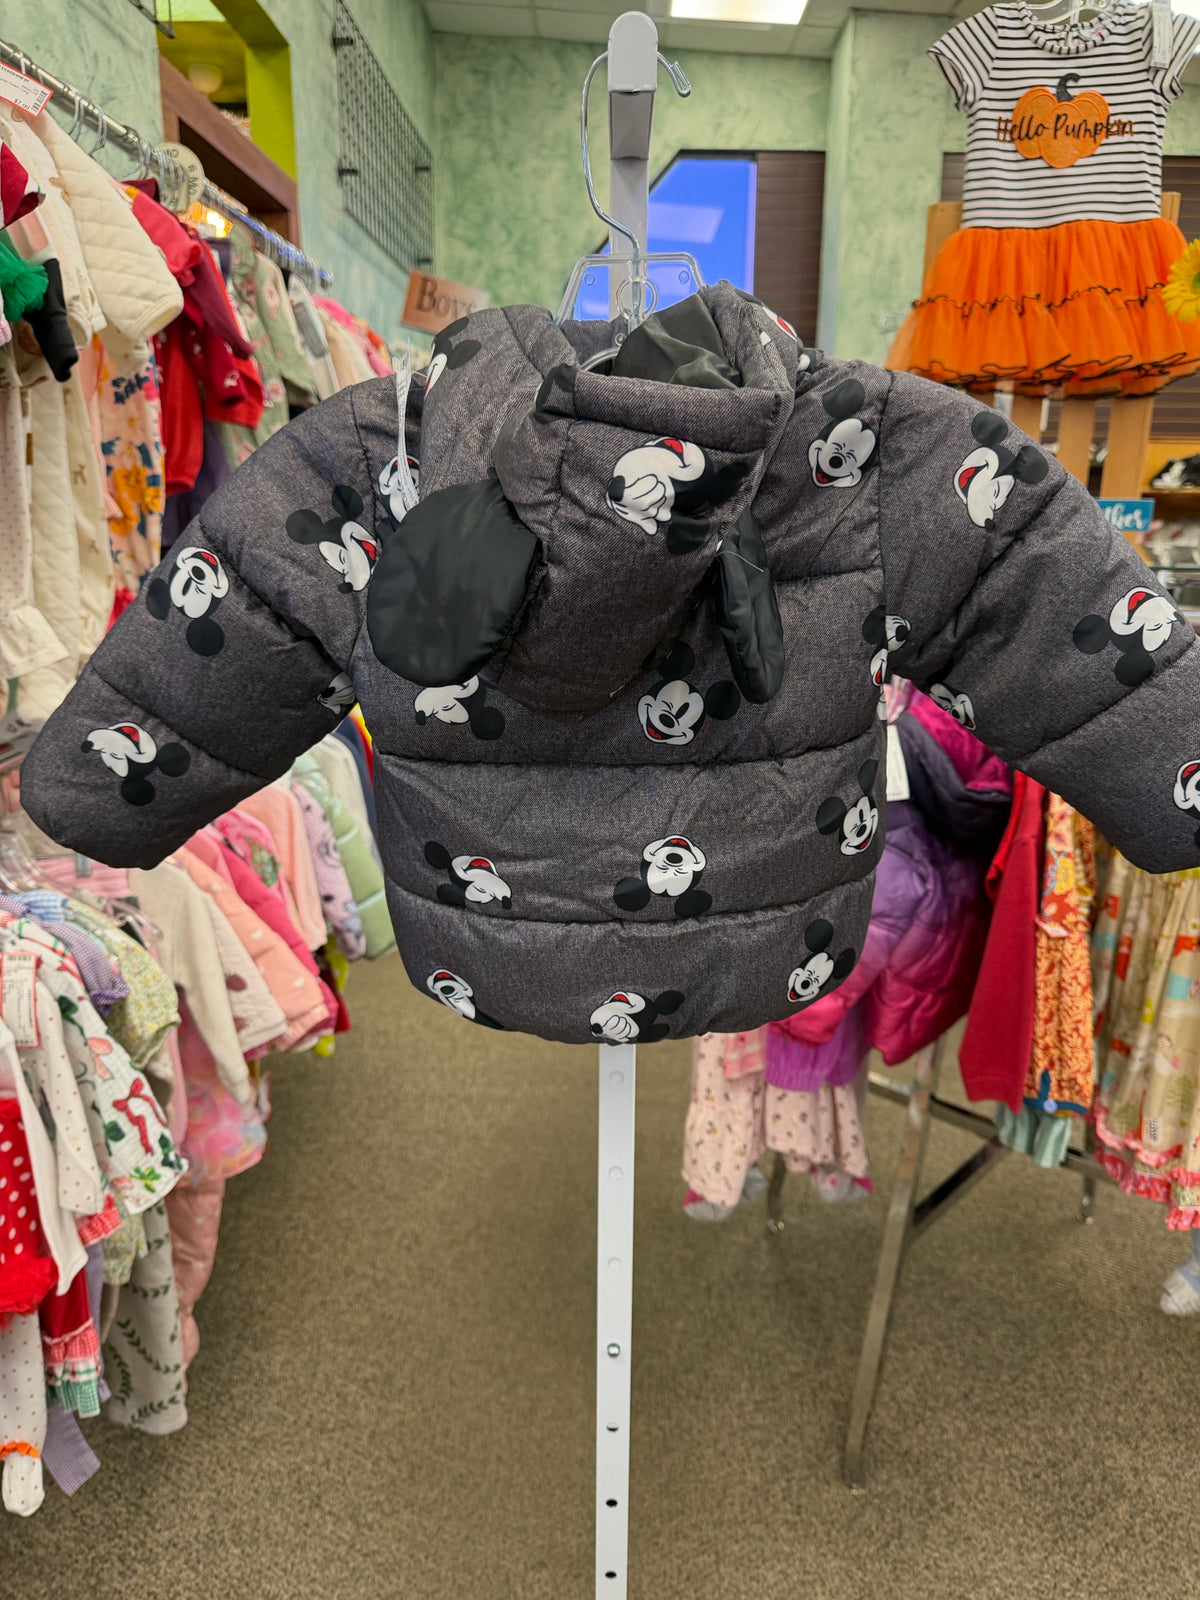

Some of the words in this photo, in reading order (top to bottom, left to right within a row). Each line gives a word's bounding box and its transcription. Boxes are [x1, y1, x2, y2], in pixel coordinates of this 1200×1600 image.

[996, 114, 1048, 142] Hello
[1053, 112, 1135, 143] Pumpkin
[1104, 502, 1144, 530] ther
